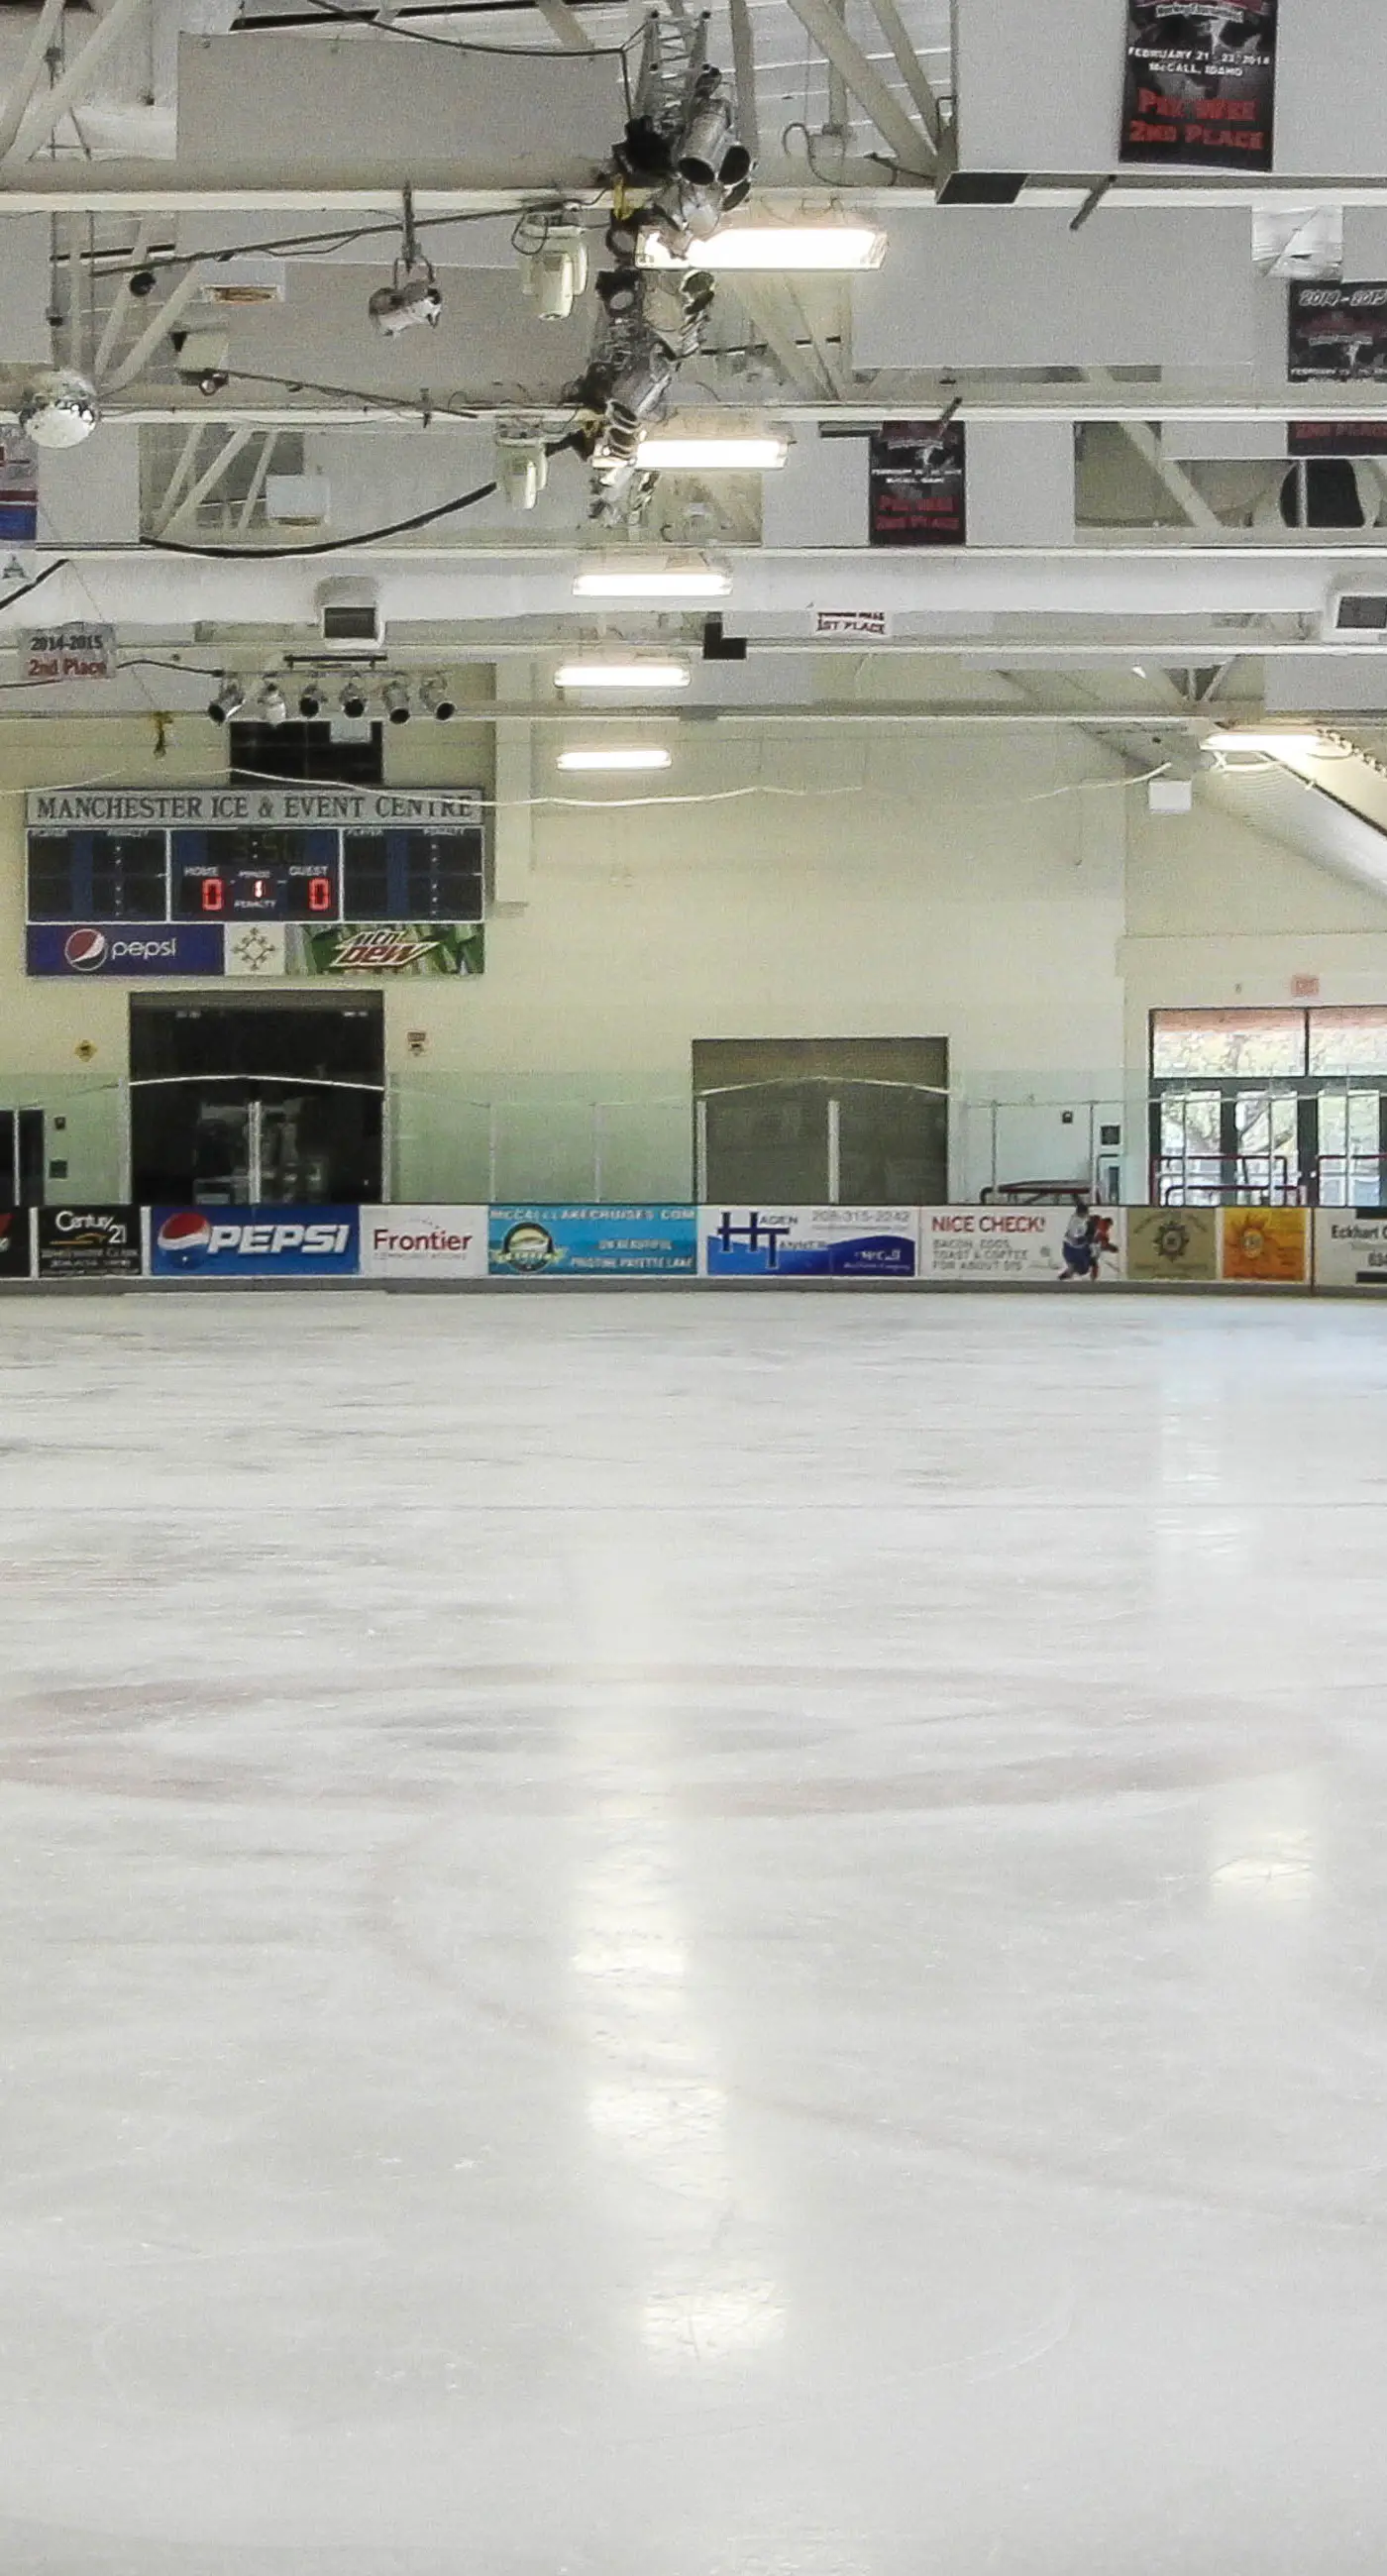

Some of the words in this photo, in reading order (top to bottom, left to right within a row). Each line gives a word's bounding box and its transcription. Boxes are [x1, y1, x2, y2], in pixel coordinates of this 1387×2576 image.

[1205, 65, 1243, 76] IDAHO
[1185, 124, 1264, 150] PLACE
[29, 659, 59, 676] 2nd
[64, 658, 107, 676] Place
[38, 797, 202, 819] MANCHESTER
[212, 797, 249, 818] ICE
[259, 797, 273, 818] &
[285, 796, 364, 818] EVENT
[375, 796, 473, 818] CENTRE
[183, 866, 219, 877] HOME
[288, 865, 329, 876] GUEST
[202, 878, 224, 911] 0
[308, 878, 331, 911] 0
[111, 937, 176, 963] pepsi
[54, 1211, 115, 1232] Century
[931, 1216, 975, 1233] NICE
[979, 1216, 1046, 1233] CHECK!
[108, 1225, 128, 1243] 21
[207, 1225, 350, 1254] PEPSI
[373, 1229, 473, 1250] Frontier
